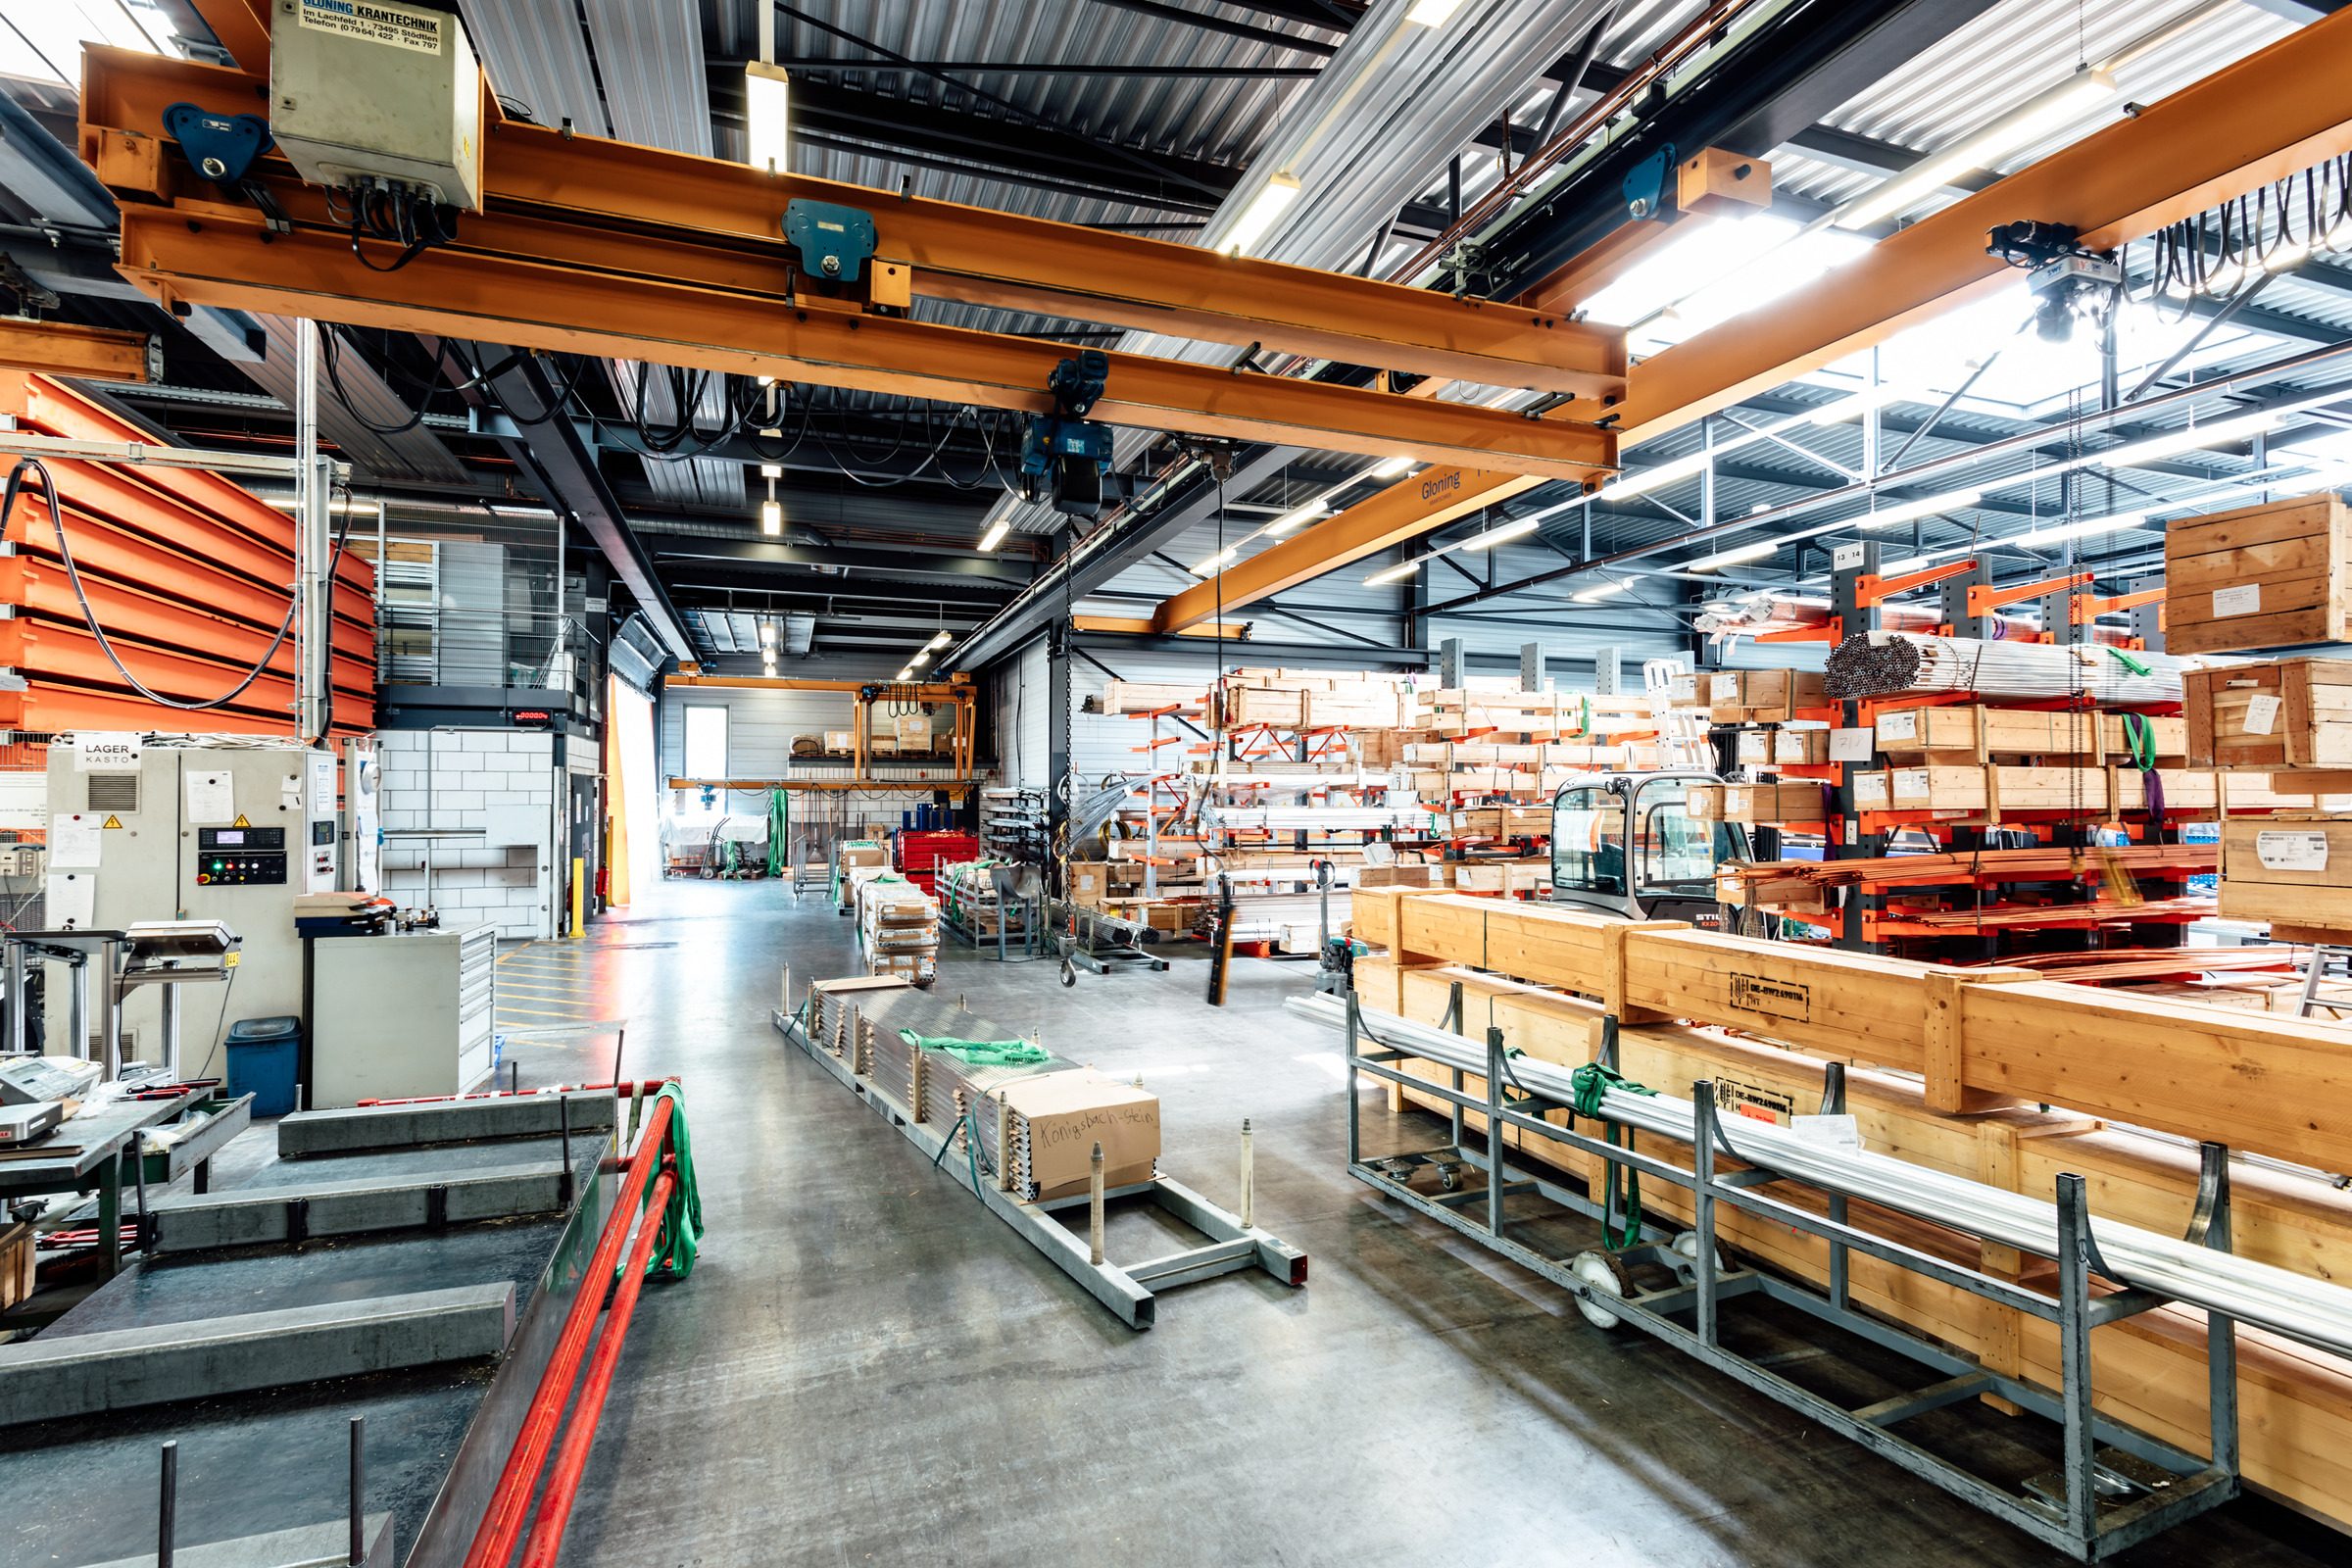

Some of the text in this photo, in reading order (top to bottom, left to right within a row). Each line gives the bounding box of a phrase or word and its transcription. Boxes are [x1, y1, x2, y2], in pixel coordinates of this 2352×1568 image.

[304, 17, 337, 28] Telefon
[404, 37, 419, 46] Fax
[318, 12, 357, 25] Lachfeld
[373, 24, 399, 34] 73495
[357, 6, 437, 32] KRANTECHNIK
[1422, 470, 1460, 499] Gloning
[85, 745, 129, 754] LAGER
